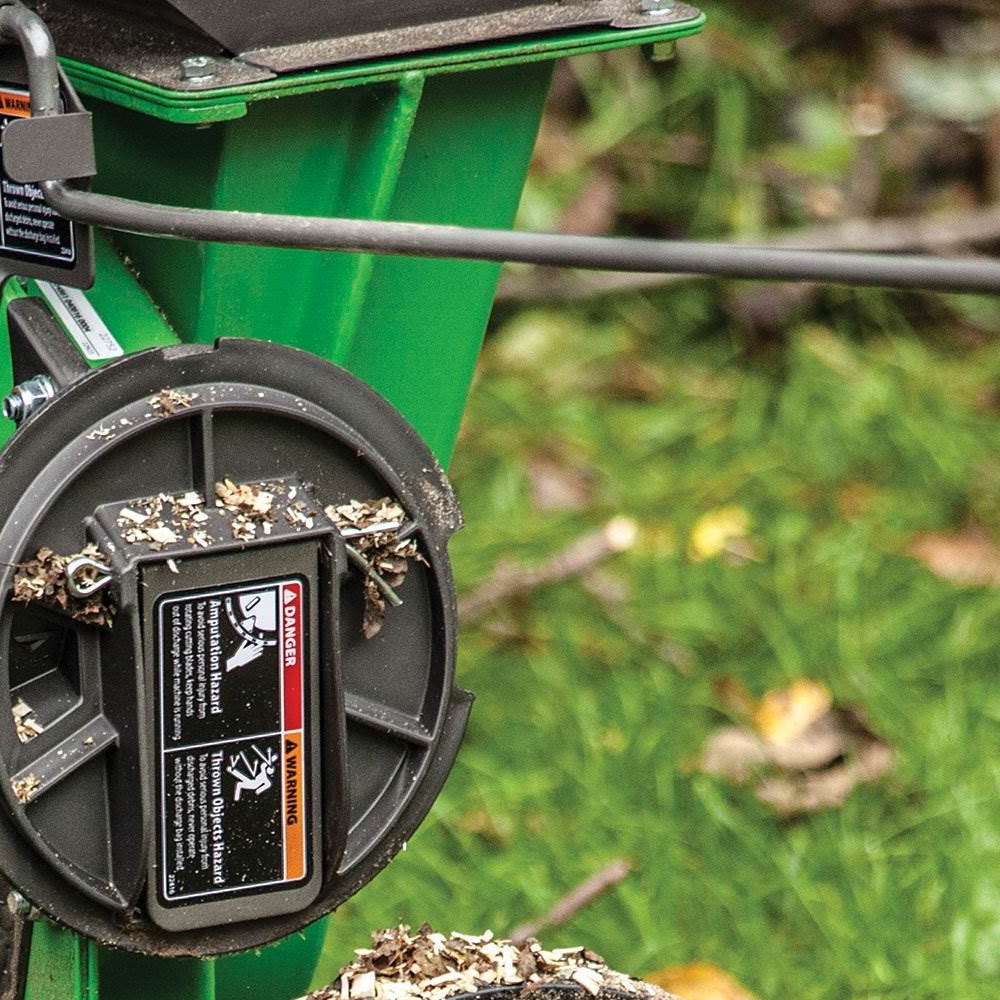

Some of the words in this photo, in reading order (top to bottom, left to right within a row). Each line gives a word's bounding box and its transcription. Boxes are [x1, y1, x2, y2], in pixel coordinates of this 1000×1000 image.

[6, 98, 31, 113] WARNI
[26, 184, 44, 201] Object
[182, 604, 192, 630] rotating
[197, 601, 206, 610] To
[172, 618, 181, 626] of
[197, 610, 205, 629] avoid
[170, 626, 181, 658] discharge
[183, 630, 193, 655] cutting
[207, 599, 222, 671] Amputation
[284, 605, 296, 667] DANGER
[173, 658, 182, 677] while
[196, 653, 206, 682] personal
[173, 678, 182, 706] machine
[184, 679, 193, 696] keep
[196, 682, 206, 702] injury
[211, 672, 222, 714] Hazard
[186, 696, 194, 716] hands
[199, 753, 208, 762] To
[174, 757, 182, 784] without
[185, 755, 195, 792] discharged
[199, 762, 208, 780] avoid
[211, 750, 224, 796] Thrown
[175, 784, 183, 795] the
[200, 781, 208, 804] serious
[286, 756, 298, 826] WARNING
[173, 796, 183, 828] discharge
[199, 804, 209, 834] personal
[210, 797, 225, 842] Objects
[174, 828, 184, 842] bag
[186, 833, 196, 859] operate
[199, 834, 208, 852] injury
[201, 853, 209, 870] from
[213, 842, 225, 884] Hazard
